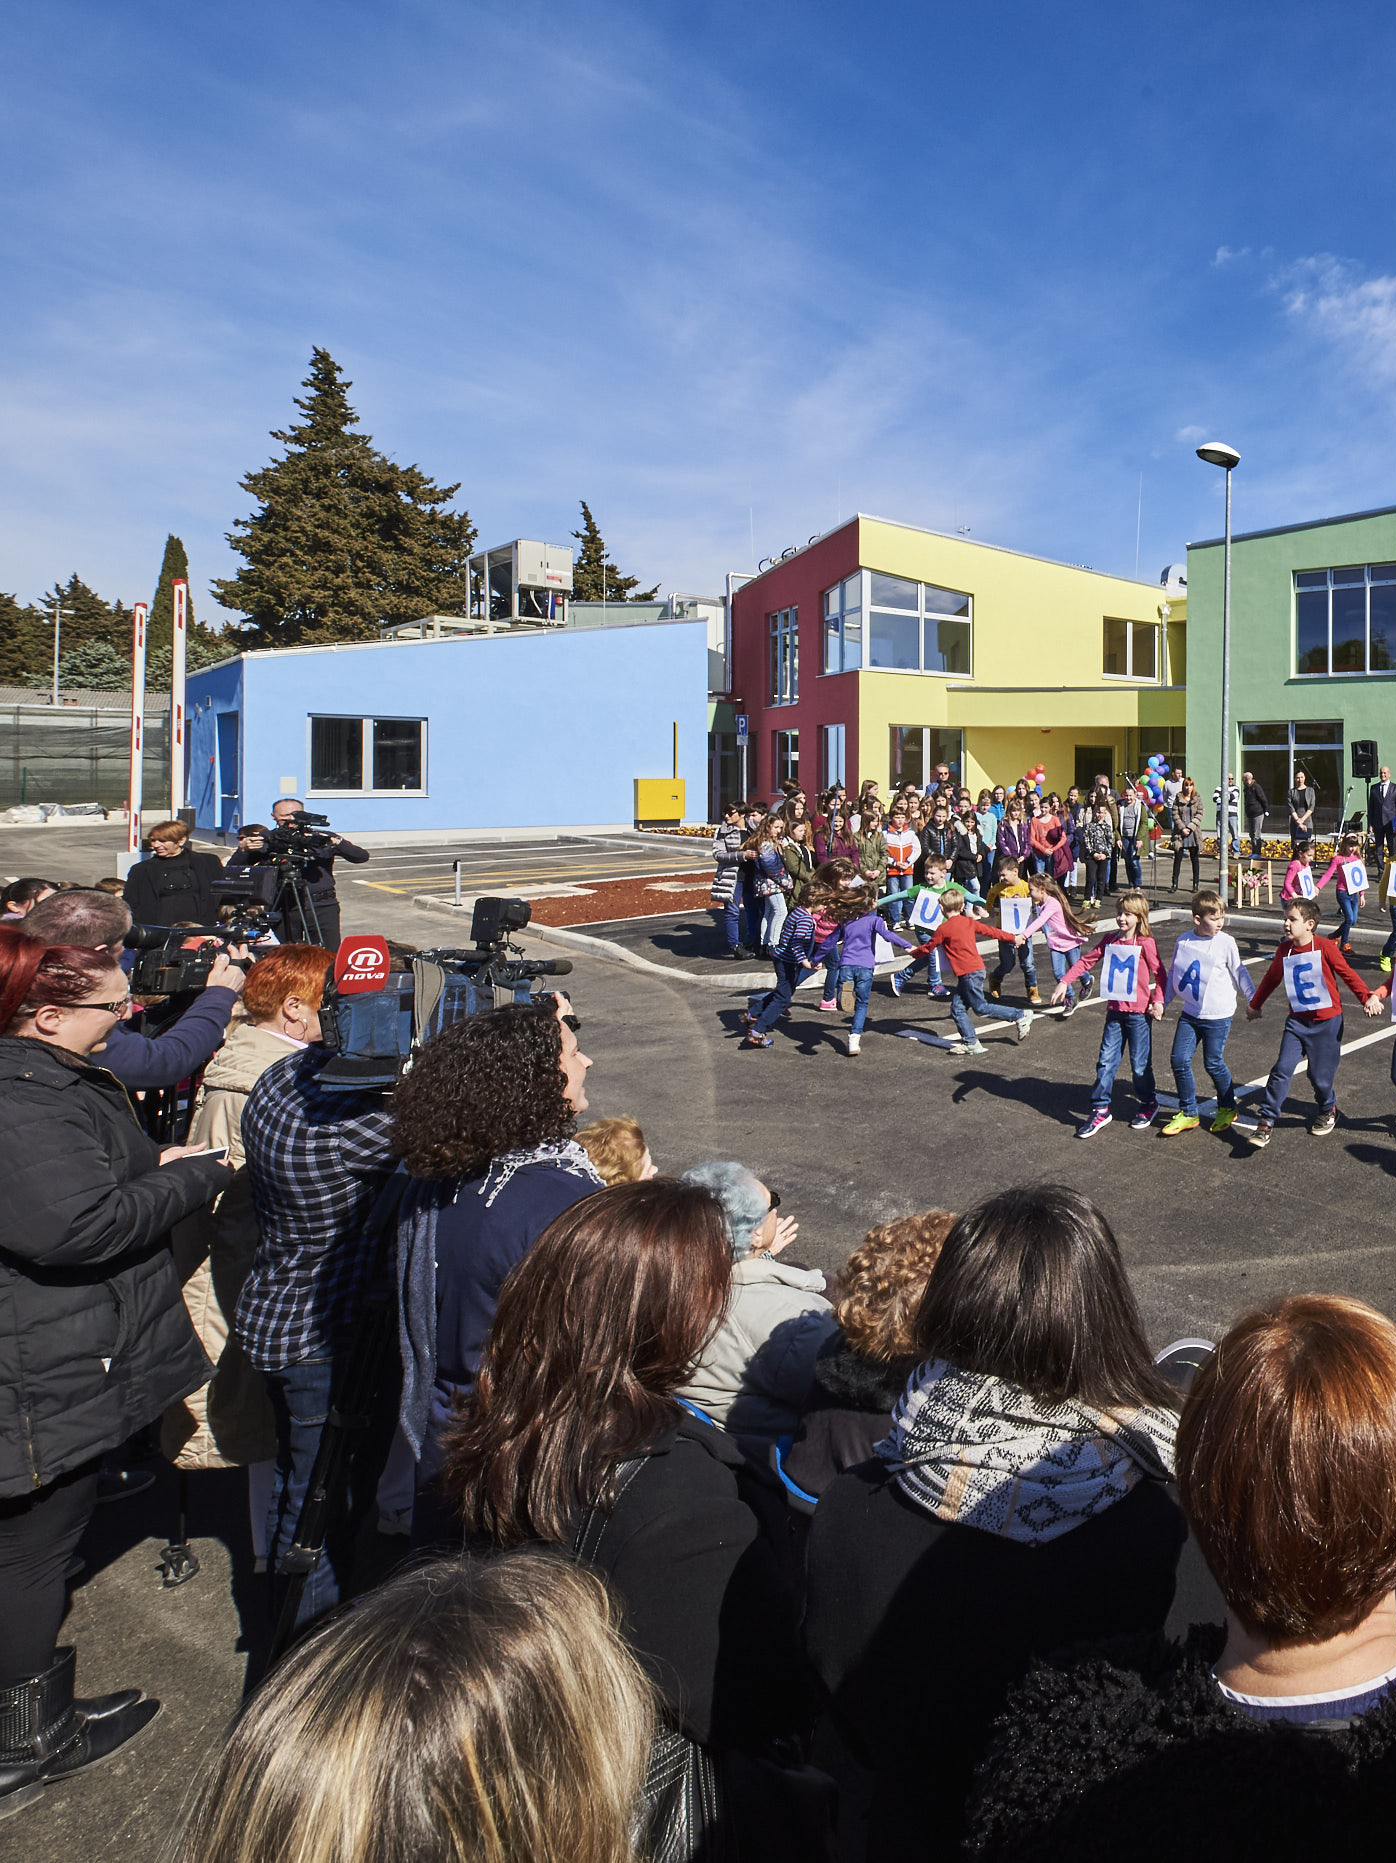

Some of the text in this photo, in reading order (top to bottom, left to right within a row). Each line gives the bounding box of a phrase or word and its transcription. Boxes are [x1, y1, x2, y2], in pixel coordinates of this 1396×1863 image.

[1304, 874, 1313, 896] D
[1351, 866, 1363, 887] O
[920, 897, 941, 924] U
[342, 972, 385, 981] nova
[1107, 953, 1135, 995] M
[1178, 959, 1200, 1002] A
[1292, 962, 1321, 1006] E
